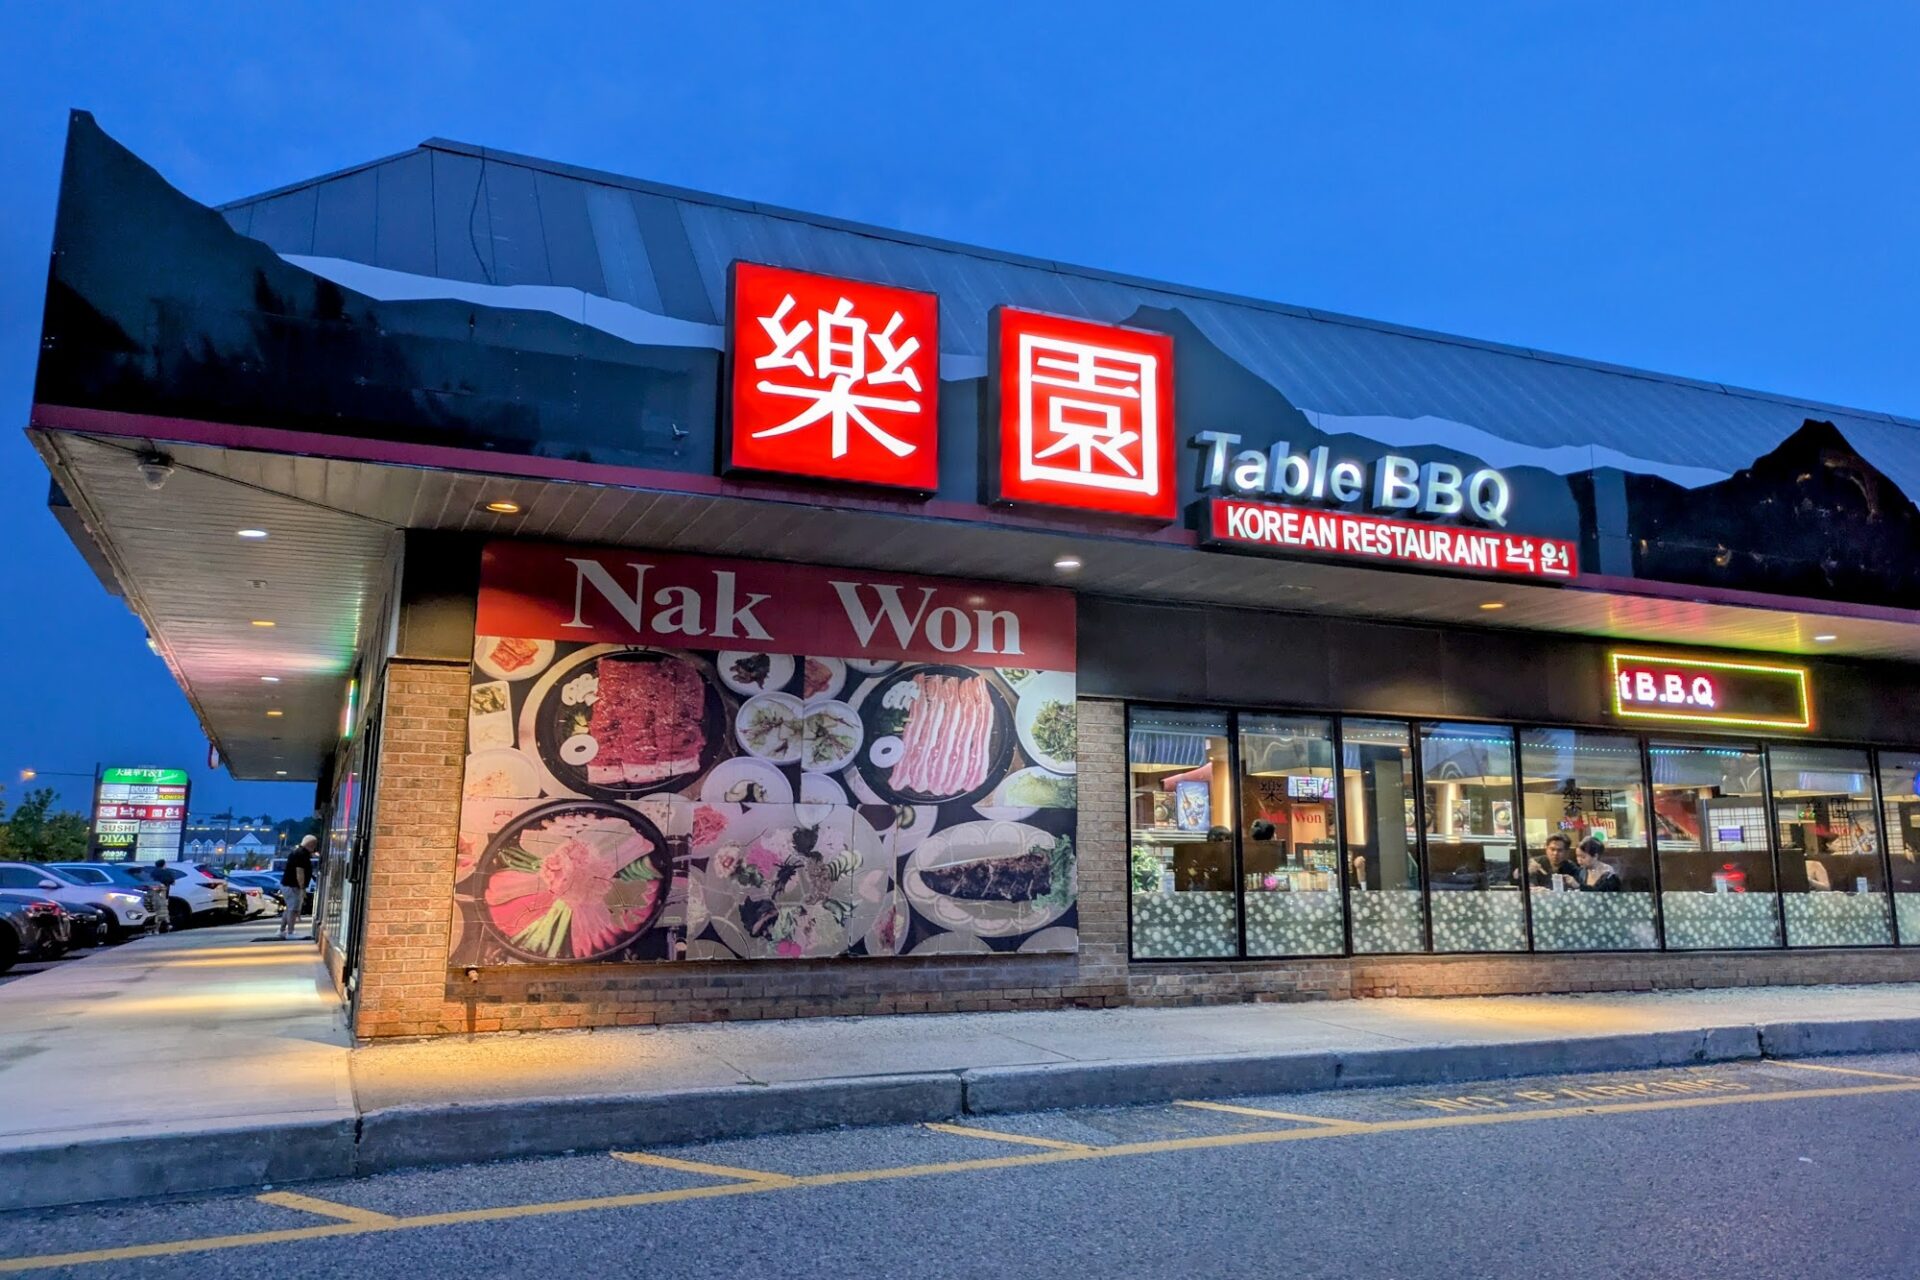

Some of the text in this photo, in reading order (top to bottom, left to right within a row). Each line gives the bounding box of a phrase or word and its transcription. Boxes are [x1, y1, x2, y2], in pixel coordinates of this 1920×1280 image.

[1197, 430, 1510, 527] Table BBQ
[1226, 505, 1501, 568] KOREAN RESTAURANT
[561, 557, 1026, 656] Nak Won
[1635, 671, 1716, 708] B.B.Q
[101, 824, 136, 833] SUSHI
[1294, 808, 1323, 824] Won
[98, 834, 135, 843] DIYAR
